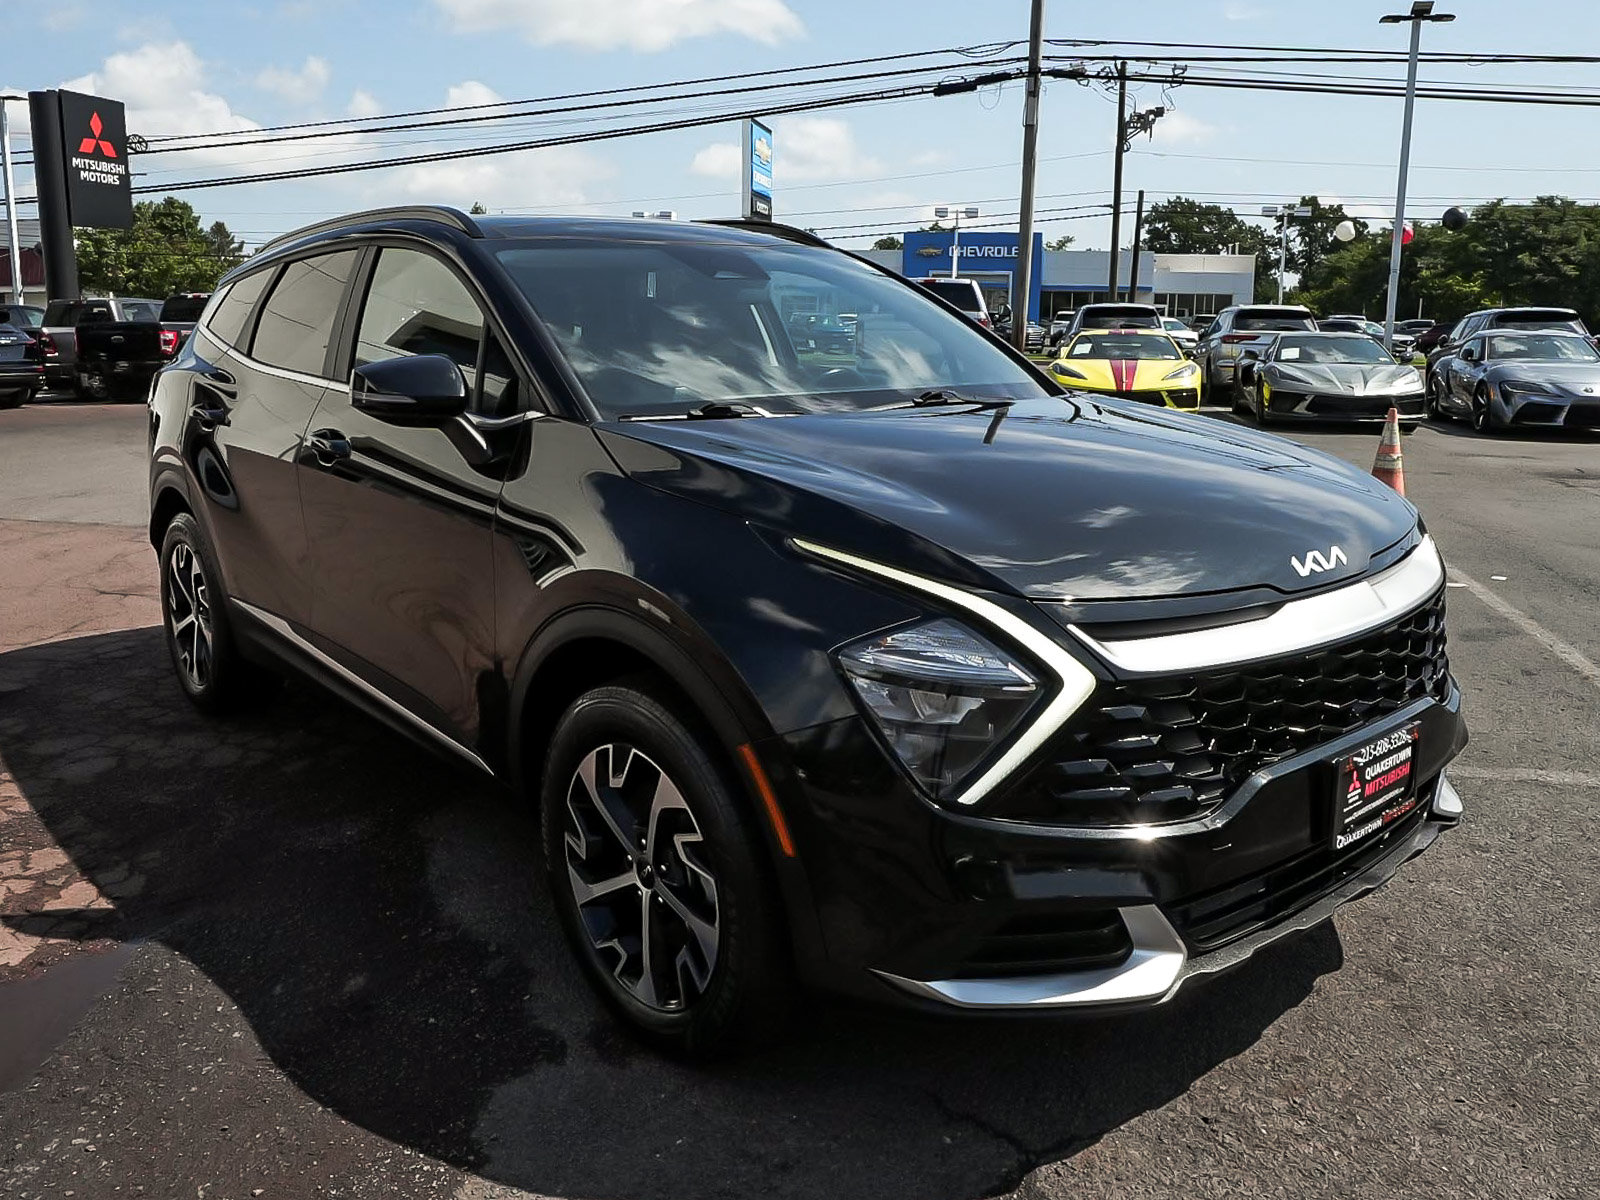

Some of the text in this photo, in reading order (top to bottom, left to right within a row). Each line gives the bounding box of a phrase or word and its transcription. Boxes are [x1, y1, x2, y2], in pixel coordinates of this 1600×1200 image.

[72, 157, 125, 175] MITSUBISHI
[80, 170, 120, 185] MOTORS
[948, 246, 1020, 258] CHEVROLE
[1291, 545, 1348, 577] KIA
[1365, 745, 1412, 780] QUAKERTOWN
[1364, 761, 1411, 798] MITSUBISHI
